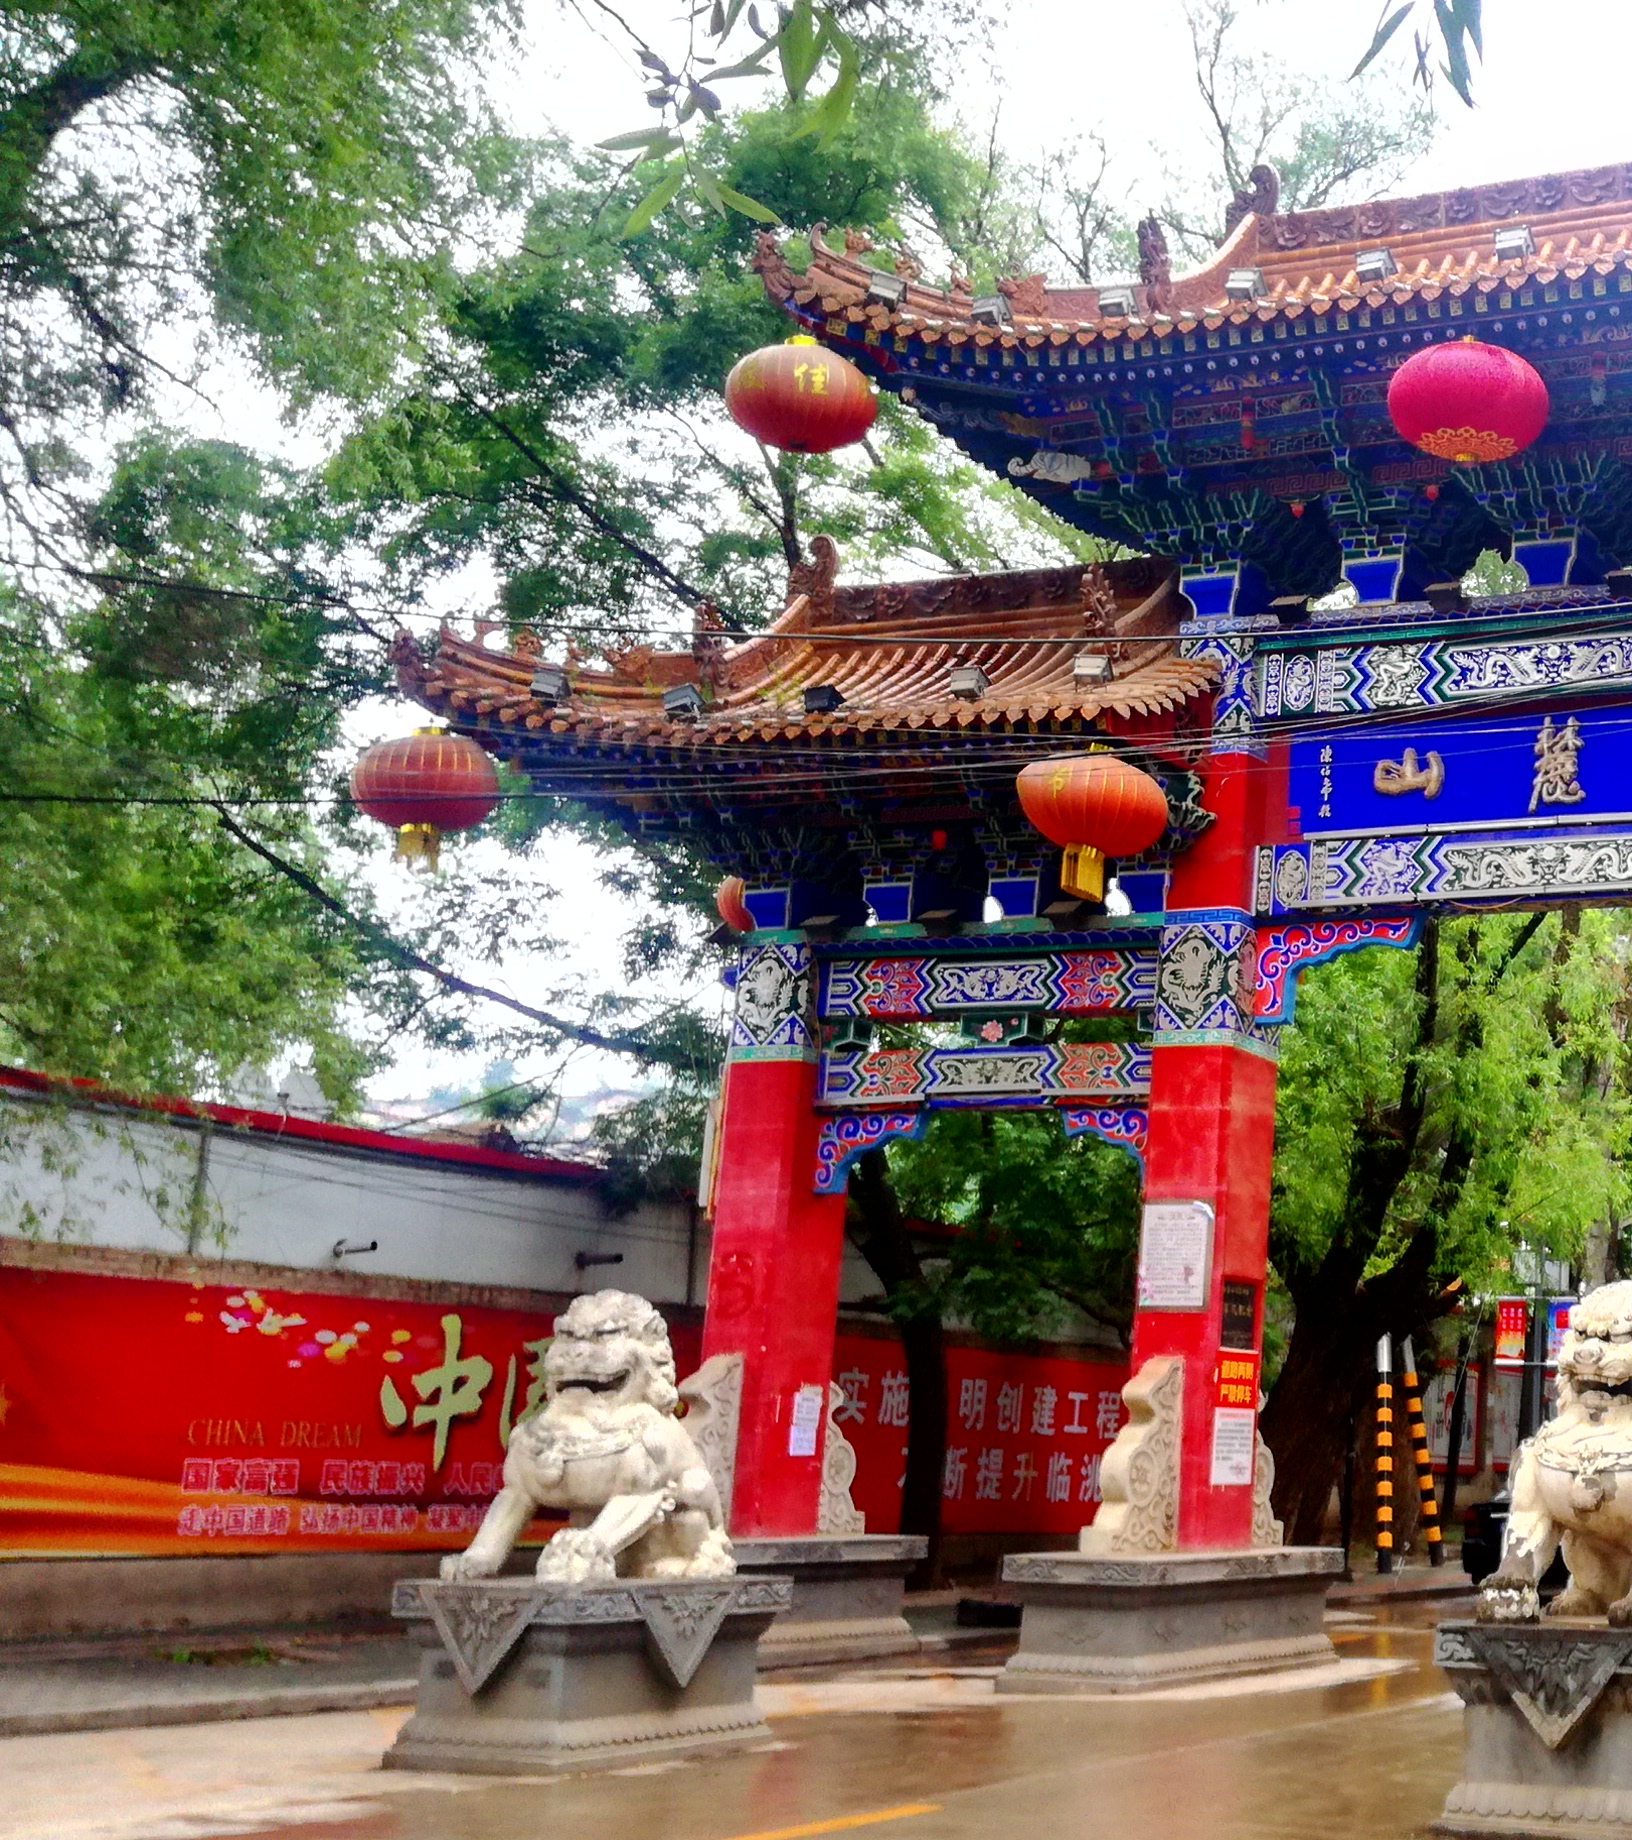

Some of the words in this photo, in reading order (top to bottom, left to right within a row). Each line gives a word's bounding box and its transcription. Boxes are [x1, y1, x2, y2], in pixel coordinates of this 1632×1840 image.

[835, 1366, 1121, 1440] 实施明创建工程
[187, 1419, 265, 1447] CHINA
[279, 1420, 362, 1449] DREAM
